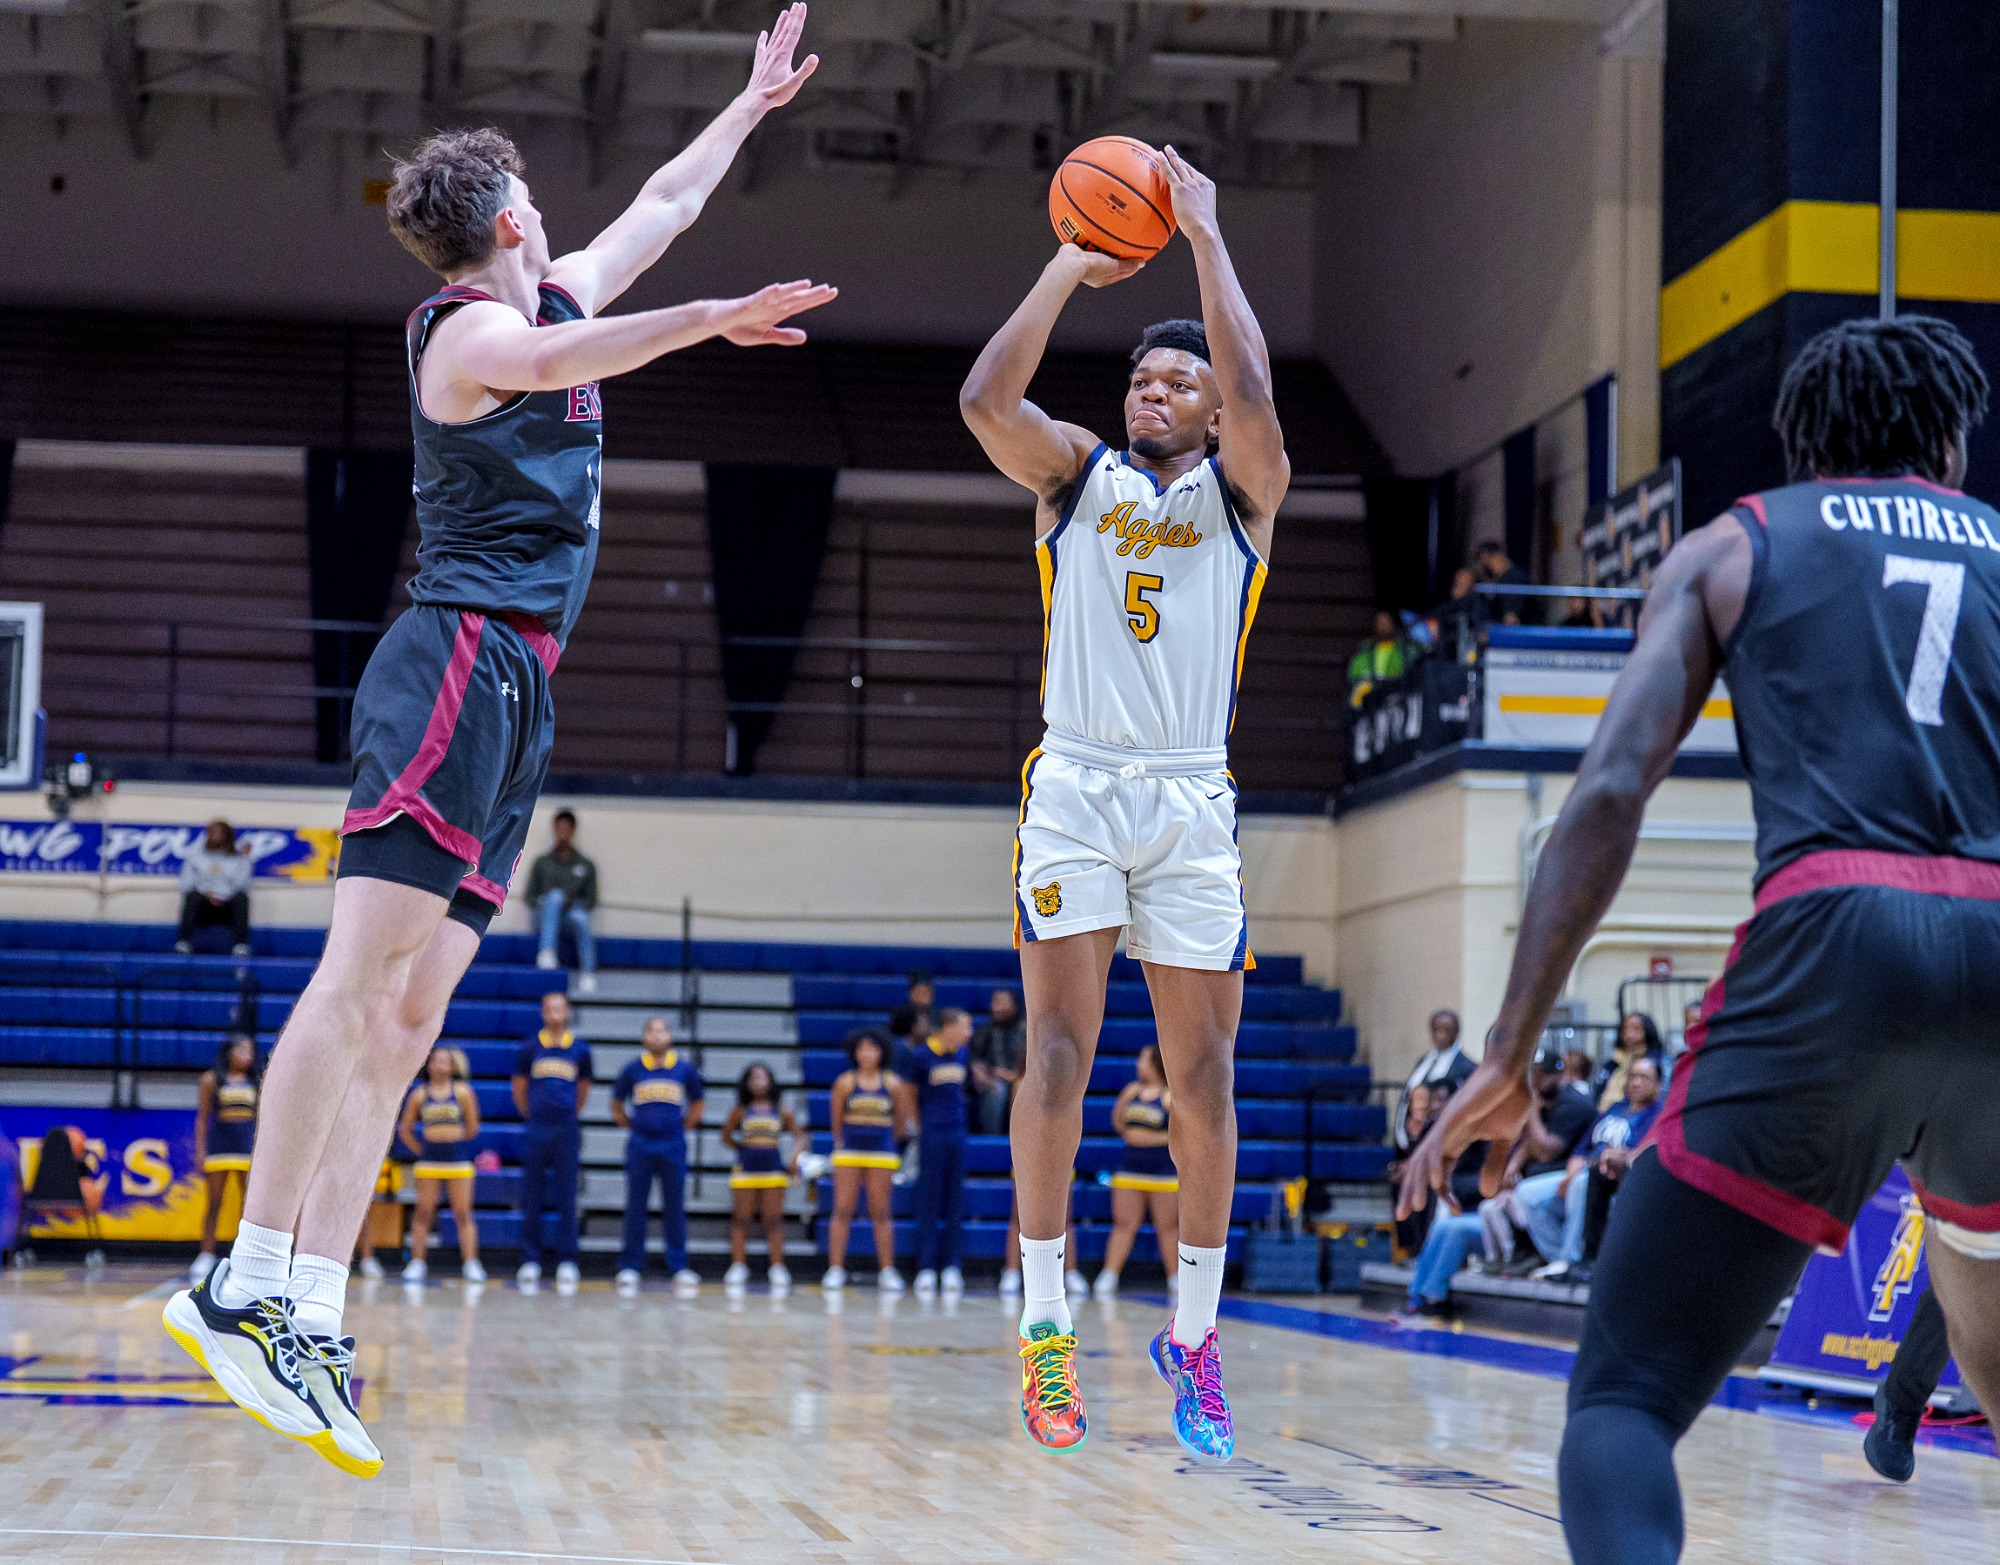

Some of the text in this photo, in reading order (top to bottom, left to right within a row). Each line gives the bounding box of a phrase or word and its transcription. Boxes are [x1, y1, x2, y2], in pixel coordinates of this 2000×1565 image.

[1097, 501, 1202, 559] Aggies
[1820, 494, 2000, 553] CUTHRELL
[1125, 571, 1164, 643] 5
[1882, 553, 1965, 727] 7
[96, 826, 289, 865] POUD
